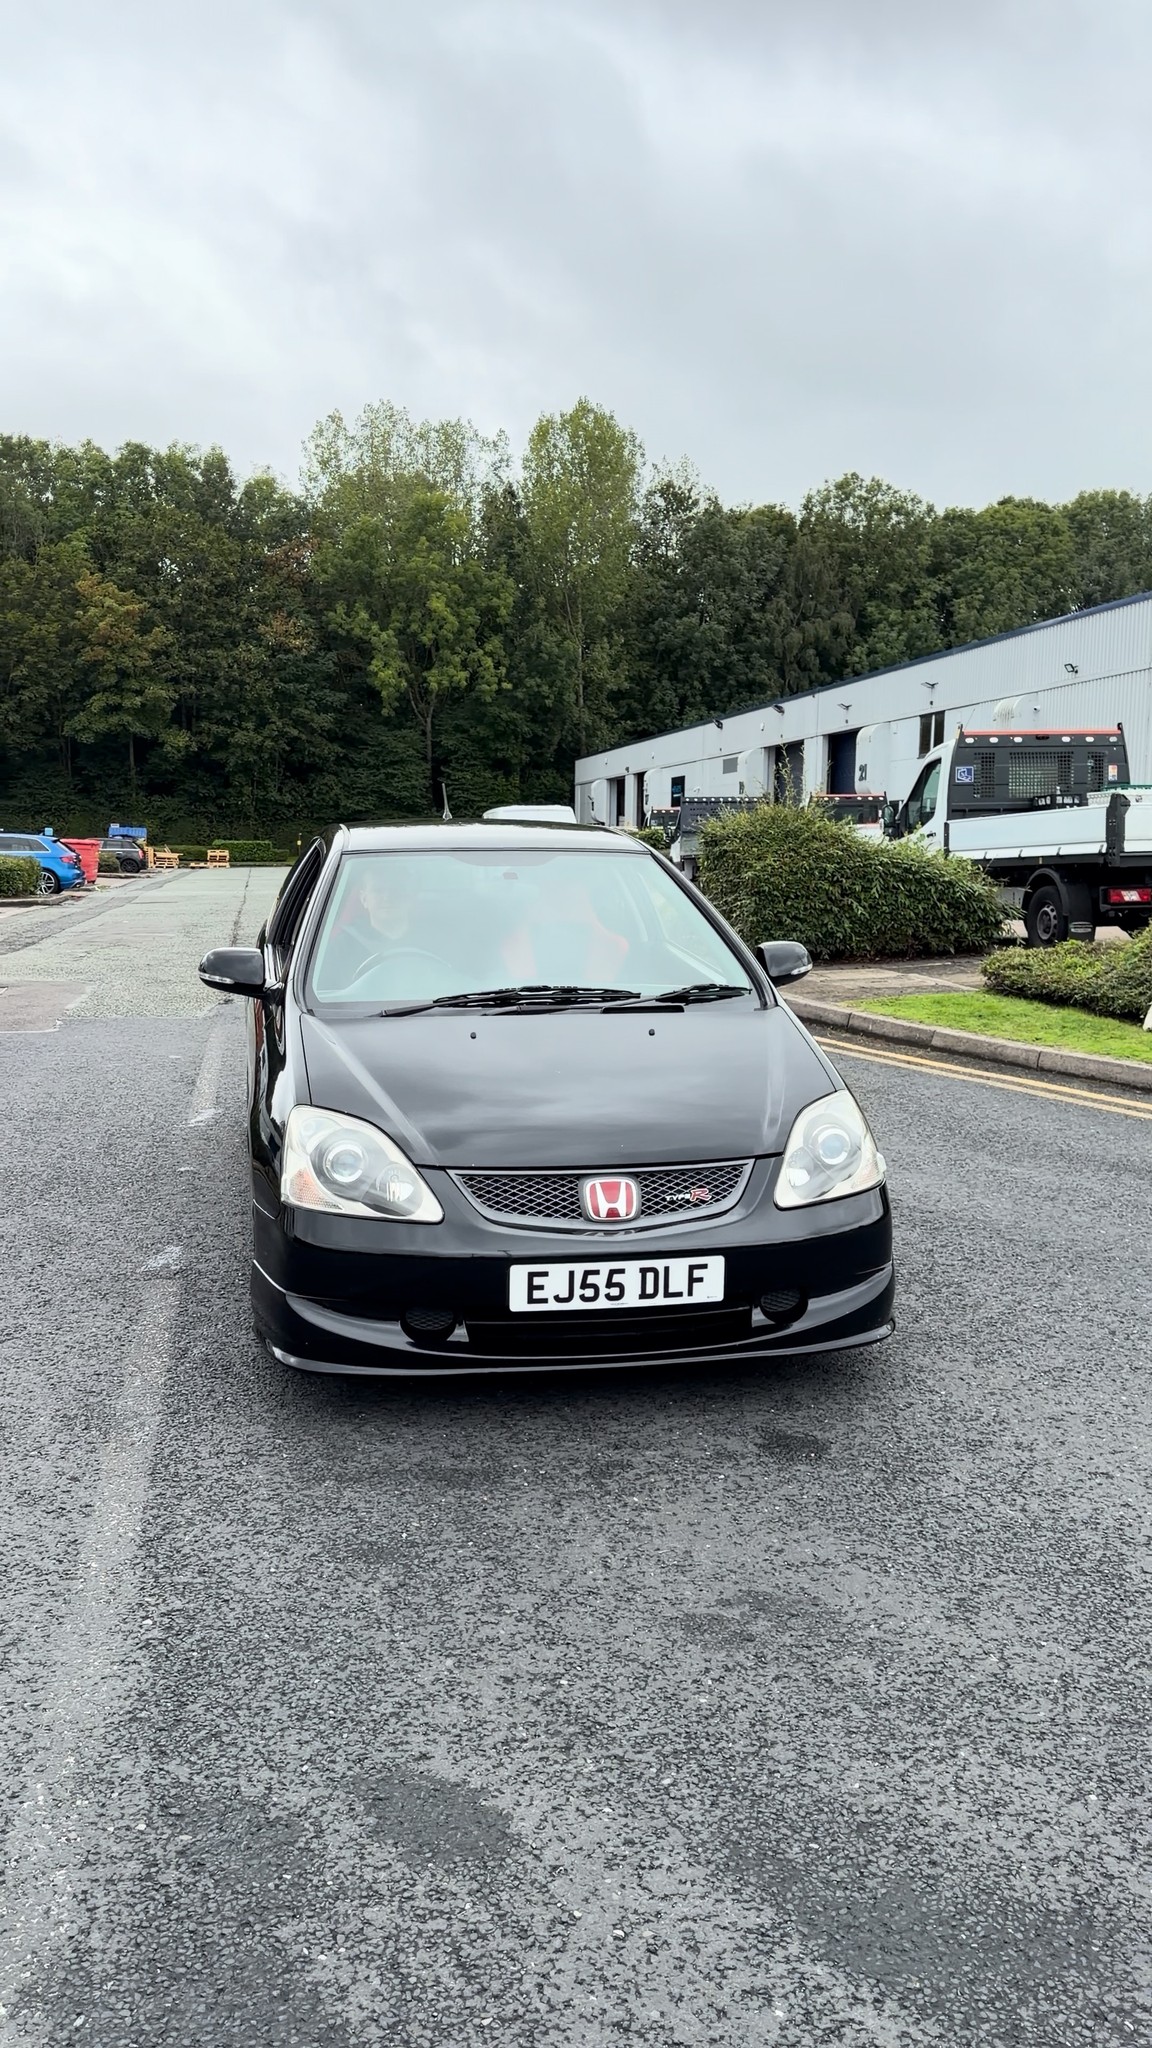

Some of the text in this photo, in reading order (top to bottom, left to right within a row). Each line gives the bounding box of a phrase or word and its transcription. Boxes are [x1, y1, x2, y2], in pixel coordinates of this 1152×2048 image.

[858, 763, 868, 781] 21
[689, 1188, 712, 1201] R
[527, 1263, 709, 1304] EJ55 DLF
